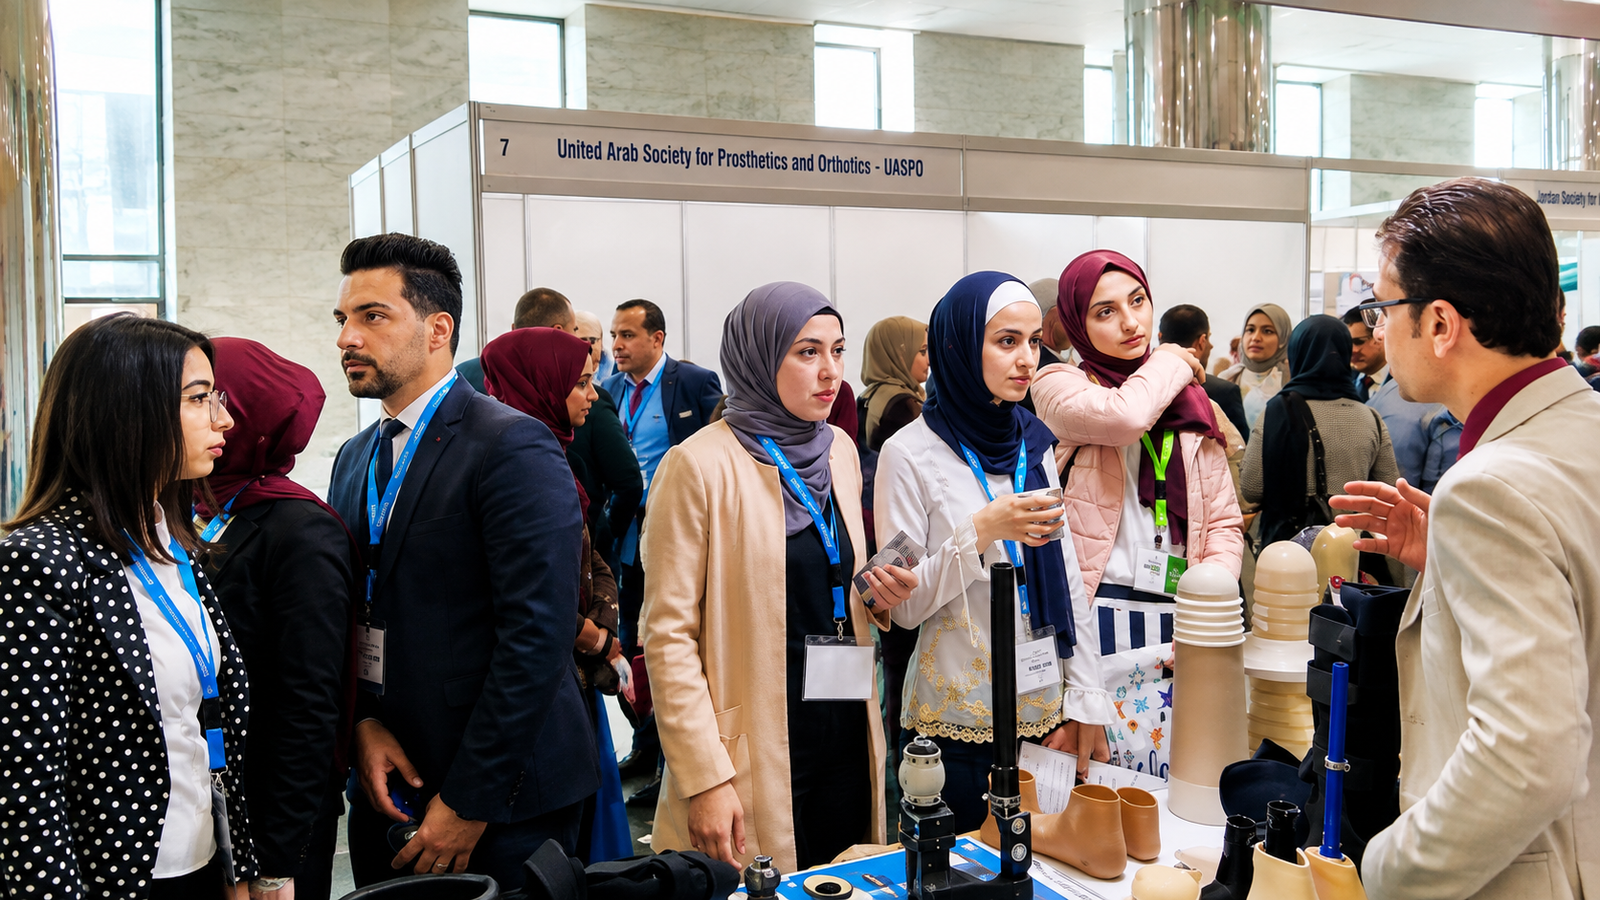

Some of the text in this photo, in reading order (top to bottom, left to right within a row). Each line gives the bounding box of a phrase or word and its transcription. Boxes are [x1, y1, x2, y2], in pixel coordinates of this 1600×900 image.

[500, 138, 509, 157] 7
[557, 138, 602, 160] United
[607, 141, 638, 162] Arab
[642, 143, 691, 169] Society
[695, 146, 713, 166] for
[718, 148, 788, 170] Prosthetics
[792, 153, 814, 172] and
[818, 154, 871, 175] Orthotics
[884, 158, 923, 177] UASPO
[1537, 190, 1560, 204] Jordan
[1561, 190, 1585, 208] Society
[1588, 192, 1597, 205] for
